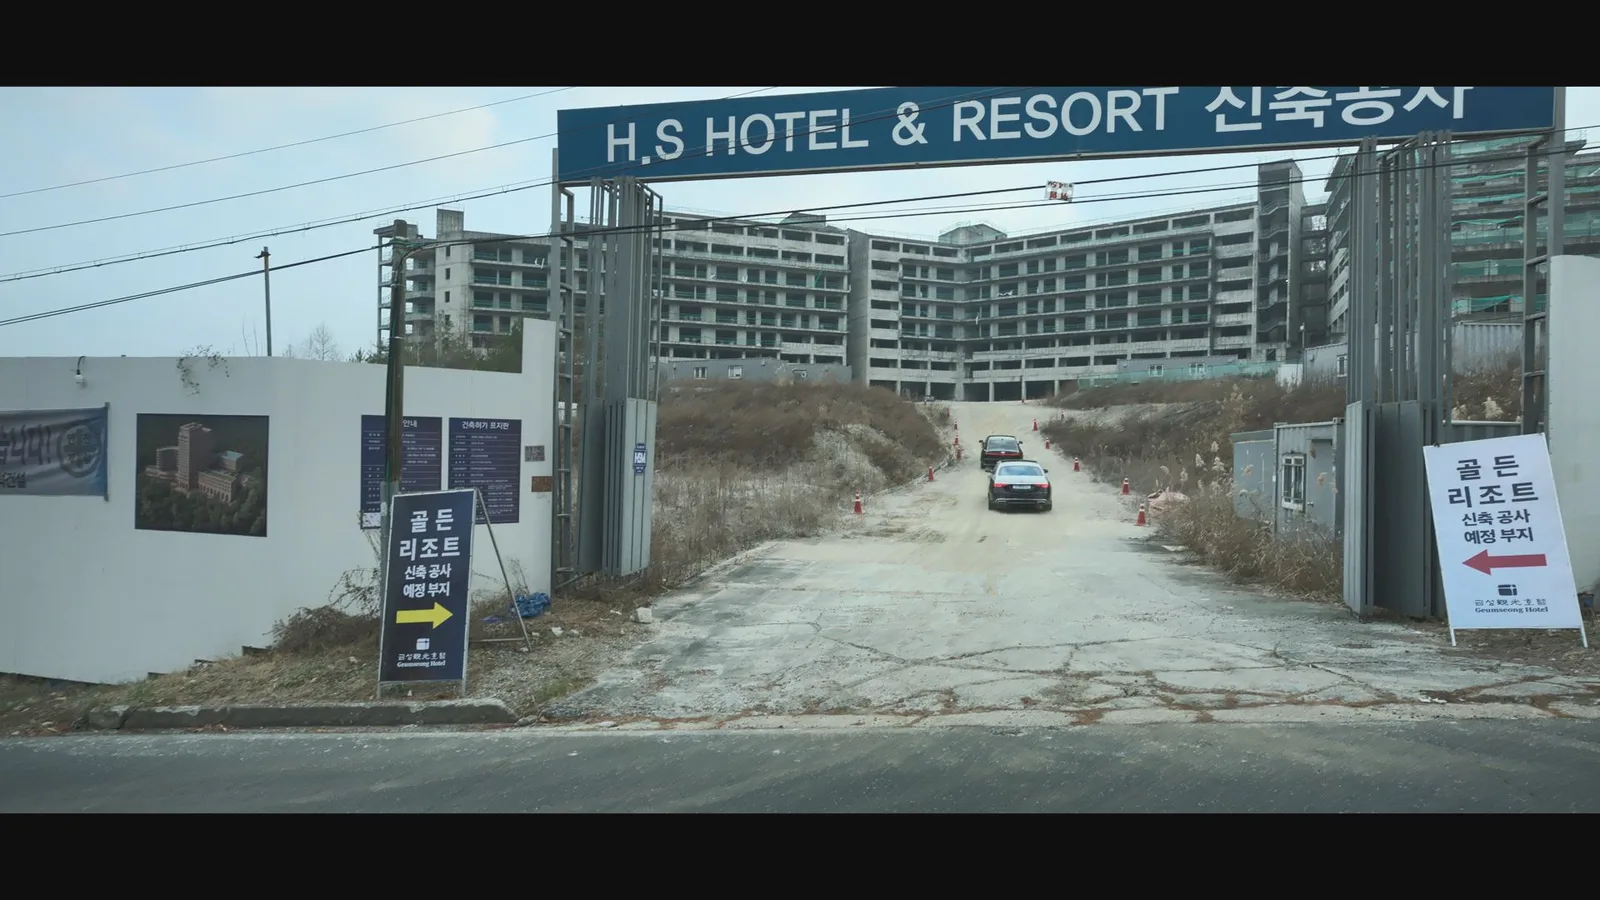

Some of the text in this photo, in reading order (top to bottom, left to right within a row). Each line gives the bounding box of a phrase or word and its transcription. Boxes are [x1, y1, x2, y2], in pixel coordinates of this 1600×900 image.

[607, 119, 684, 165] H.S
[706, 108, 869, 156] HOTEL
[892, 101, 928, 146] &
[953, 86, 1180, 142] RESORT
[461, 420, 510, 431] 건축허가 표지판
[1447, 481, 1540, 509] 리조트
[1461, 508, 1531, 527] 신축 공사
[1464, 526, 1534, 545] 예정 부지
[399, 536, 460, 561] 리조트
[404, 562, 452, 580] 신축 공사
[402, 581, 451, 599] 예정 부지
[1524, 604, 1549, 613] Hotel
[430, 659, 447, 668] Hotel
